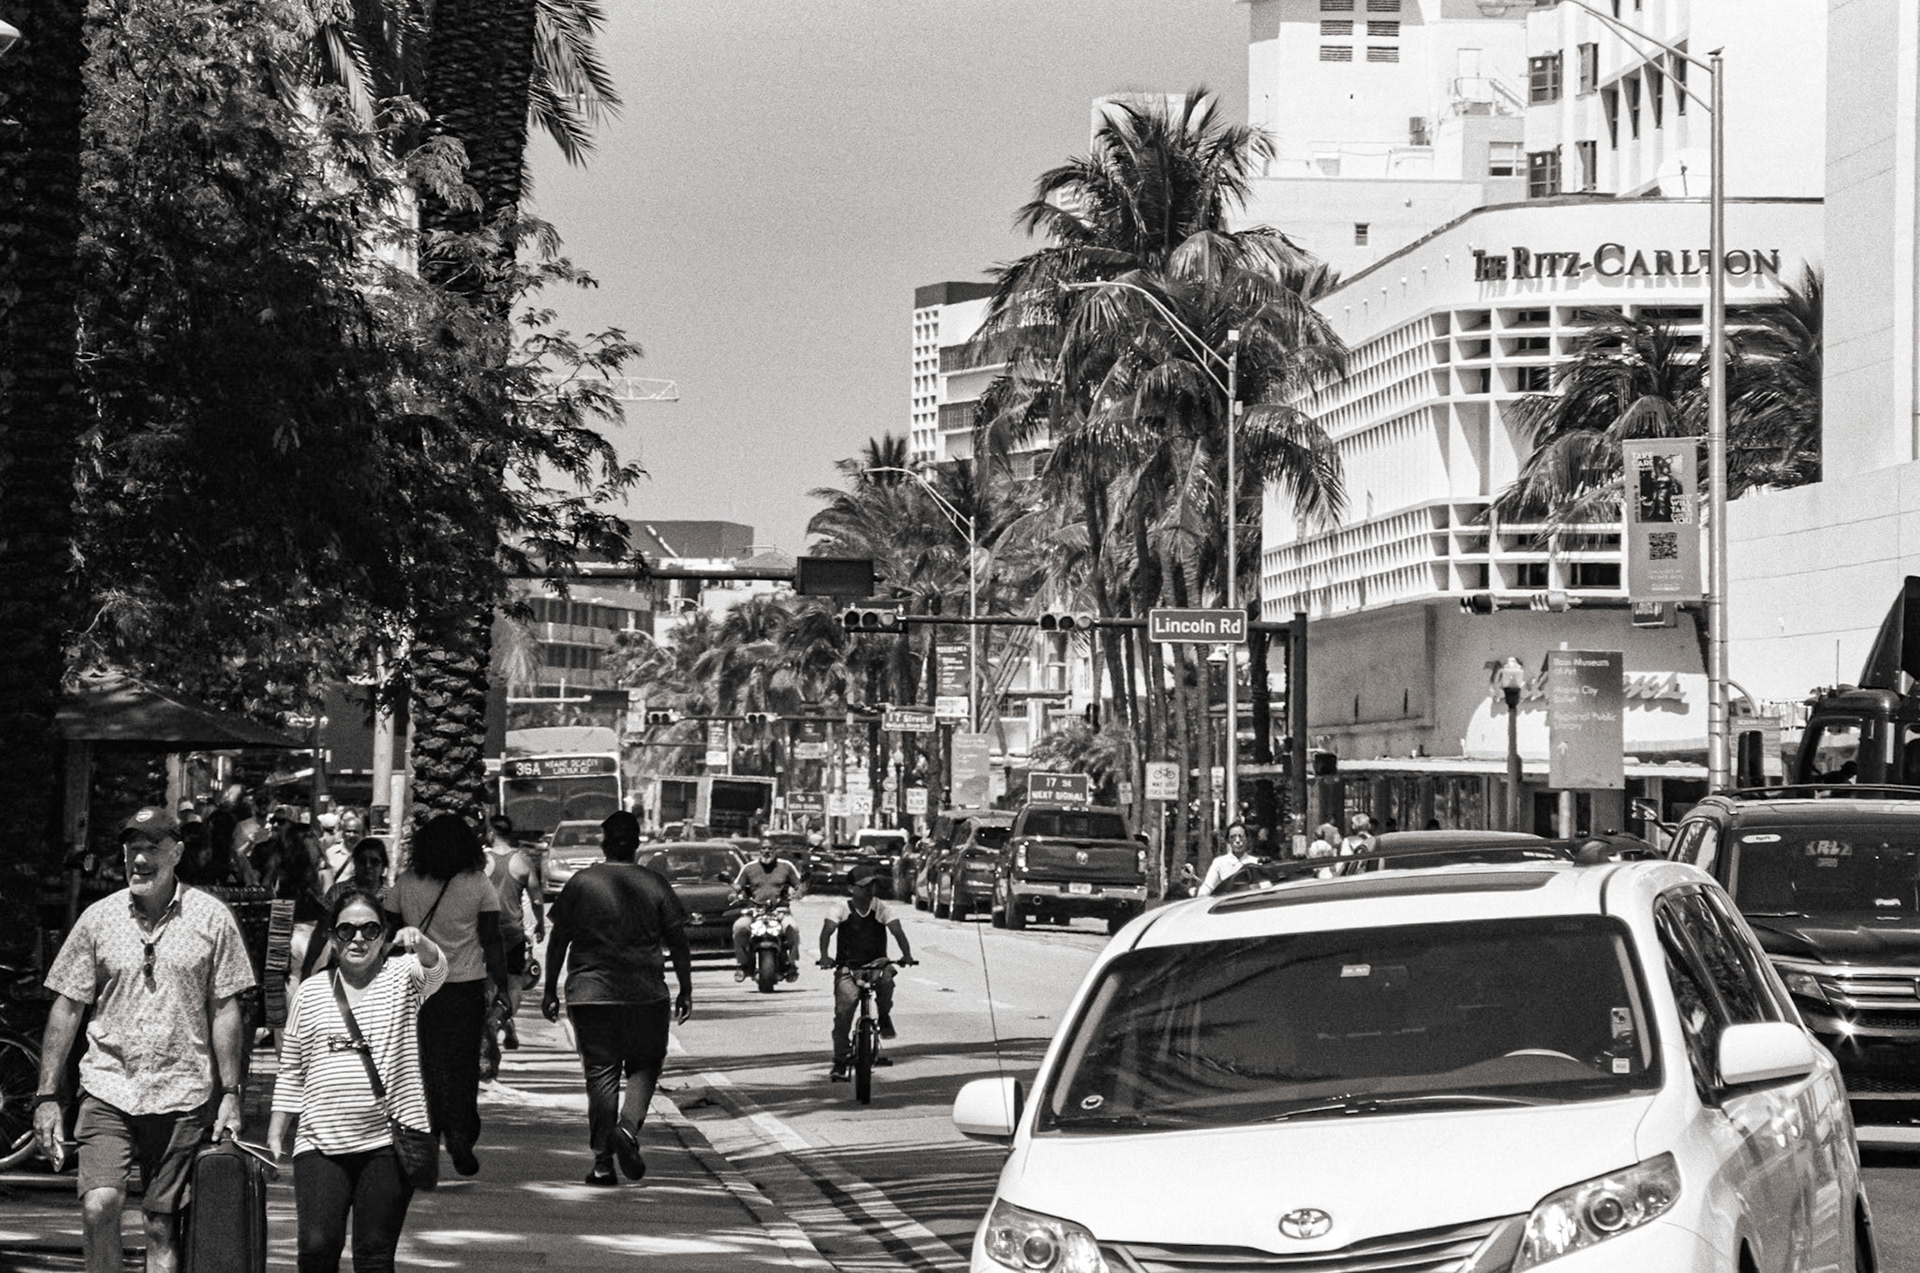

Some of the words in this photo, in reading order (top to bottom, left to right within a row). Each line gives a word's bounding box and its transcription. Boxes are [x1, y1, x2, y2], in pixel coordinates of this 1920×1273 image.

[1155, 617, 1215, 634] Lincoln
[1220, 618, 1241, 634] Rd
[1573, 658, 1609, 667] Museum
[1582, 685, 1599, 697] City
[1046, 777, 1057, 787] 17
[1061, 779, 1072, 787] St
[1032, 790, 1053, 799] NEXT
[1055, 791, 1085, 801] SIGNAL
[854, 802, 869, 811] 30
